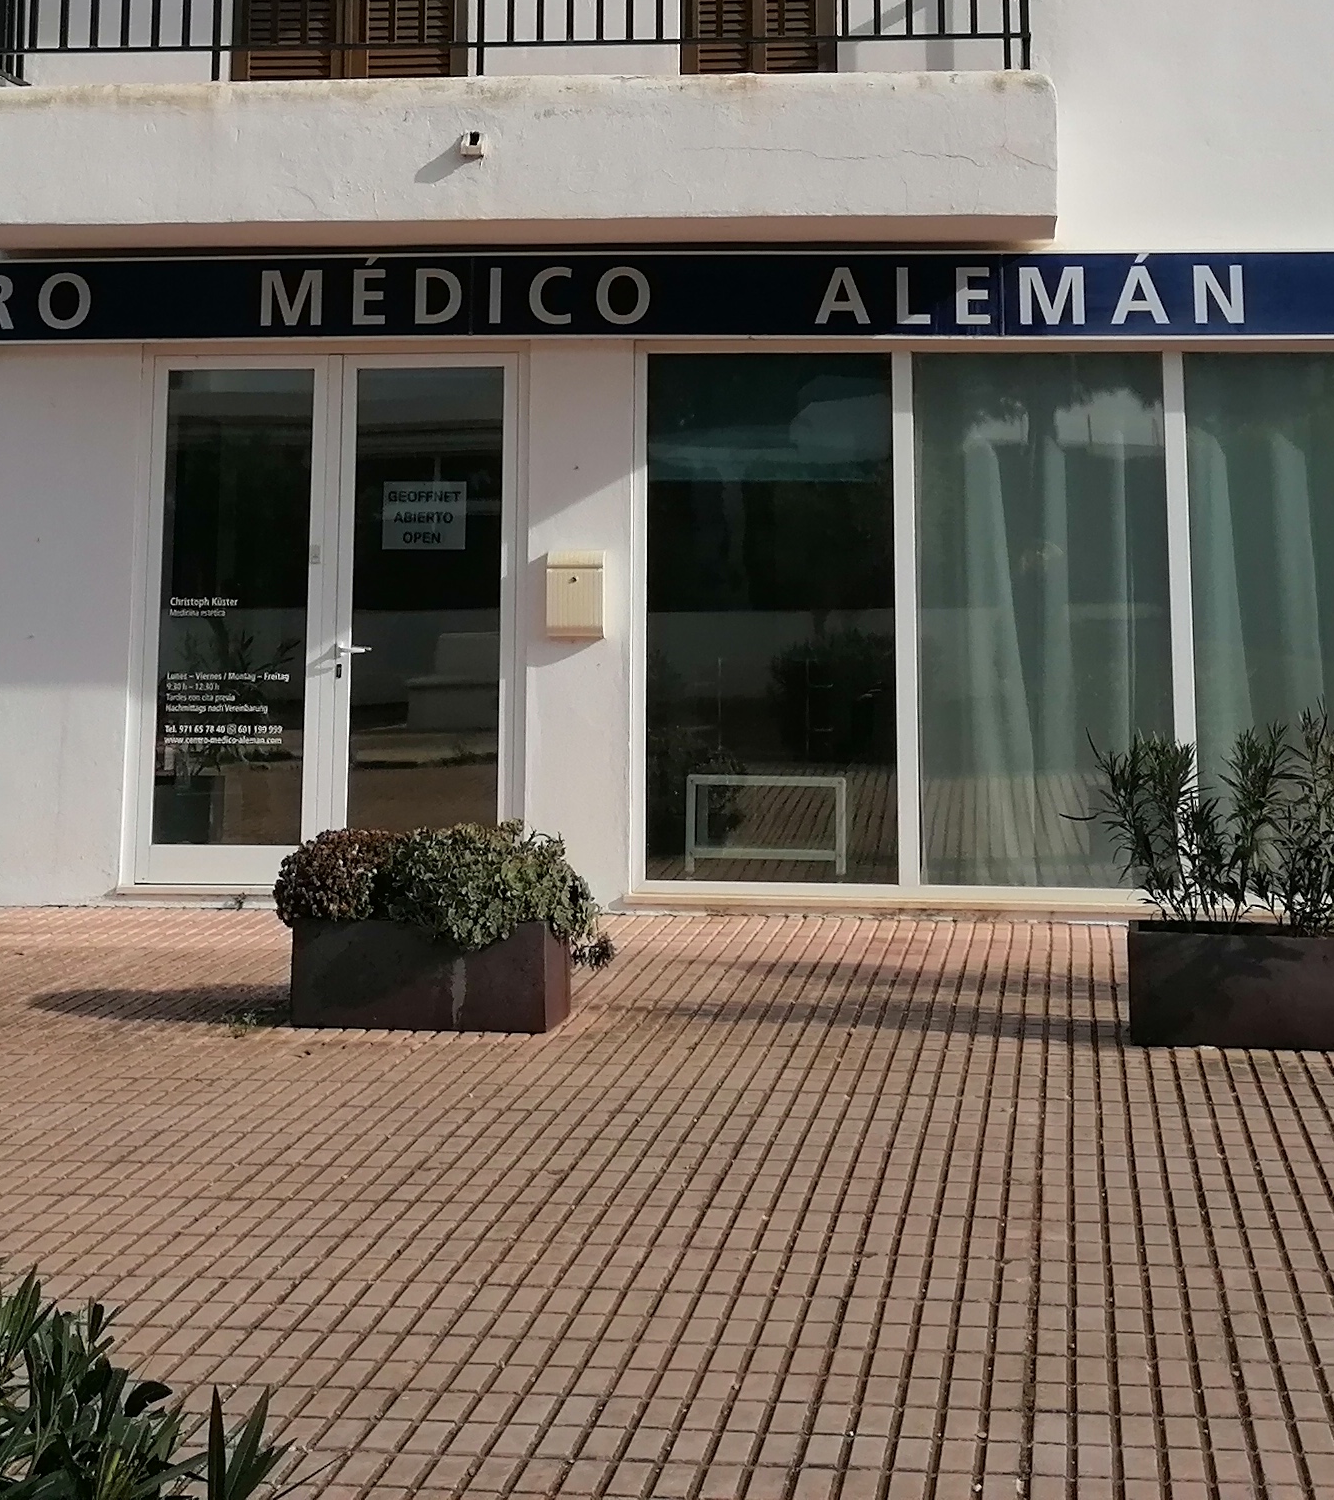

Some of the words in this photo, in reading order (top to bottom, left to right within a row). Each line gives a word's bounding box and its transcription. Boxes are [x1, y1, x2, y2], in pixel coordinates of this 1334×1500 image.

[259, 257, 652, 327] MÉDICO
[814, 253, 1246, 326] ALEMÁN
[393, 511, 454, 524] ABIERTO
[402, 531, 441, 544] OPEN
[169, 597, 210, 608] Christoph
[166, 672, 187, 680] Lunes
[195, 672, 222, 680] Viernes
[227, 672, 256, 682] Montag
[263, 672, 290, 682] Freitag
[164, 724, 177, 733] Tel.
[178, 724, 192, 733] 971
[216, 724, 226, 733] 40
